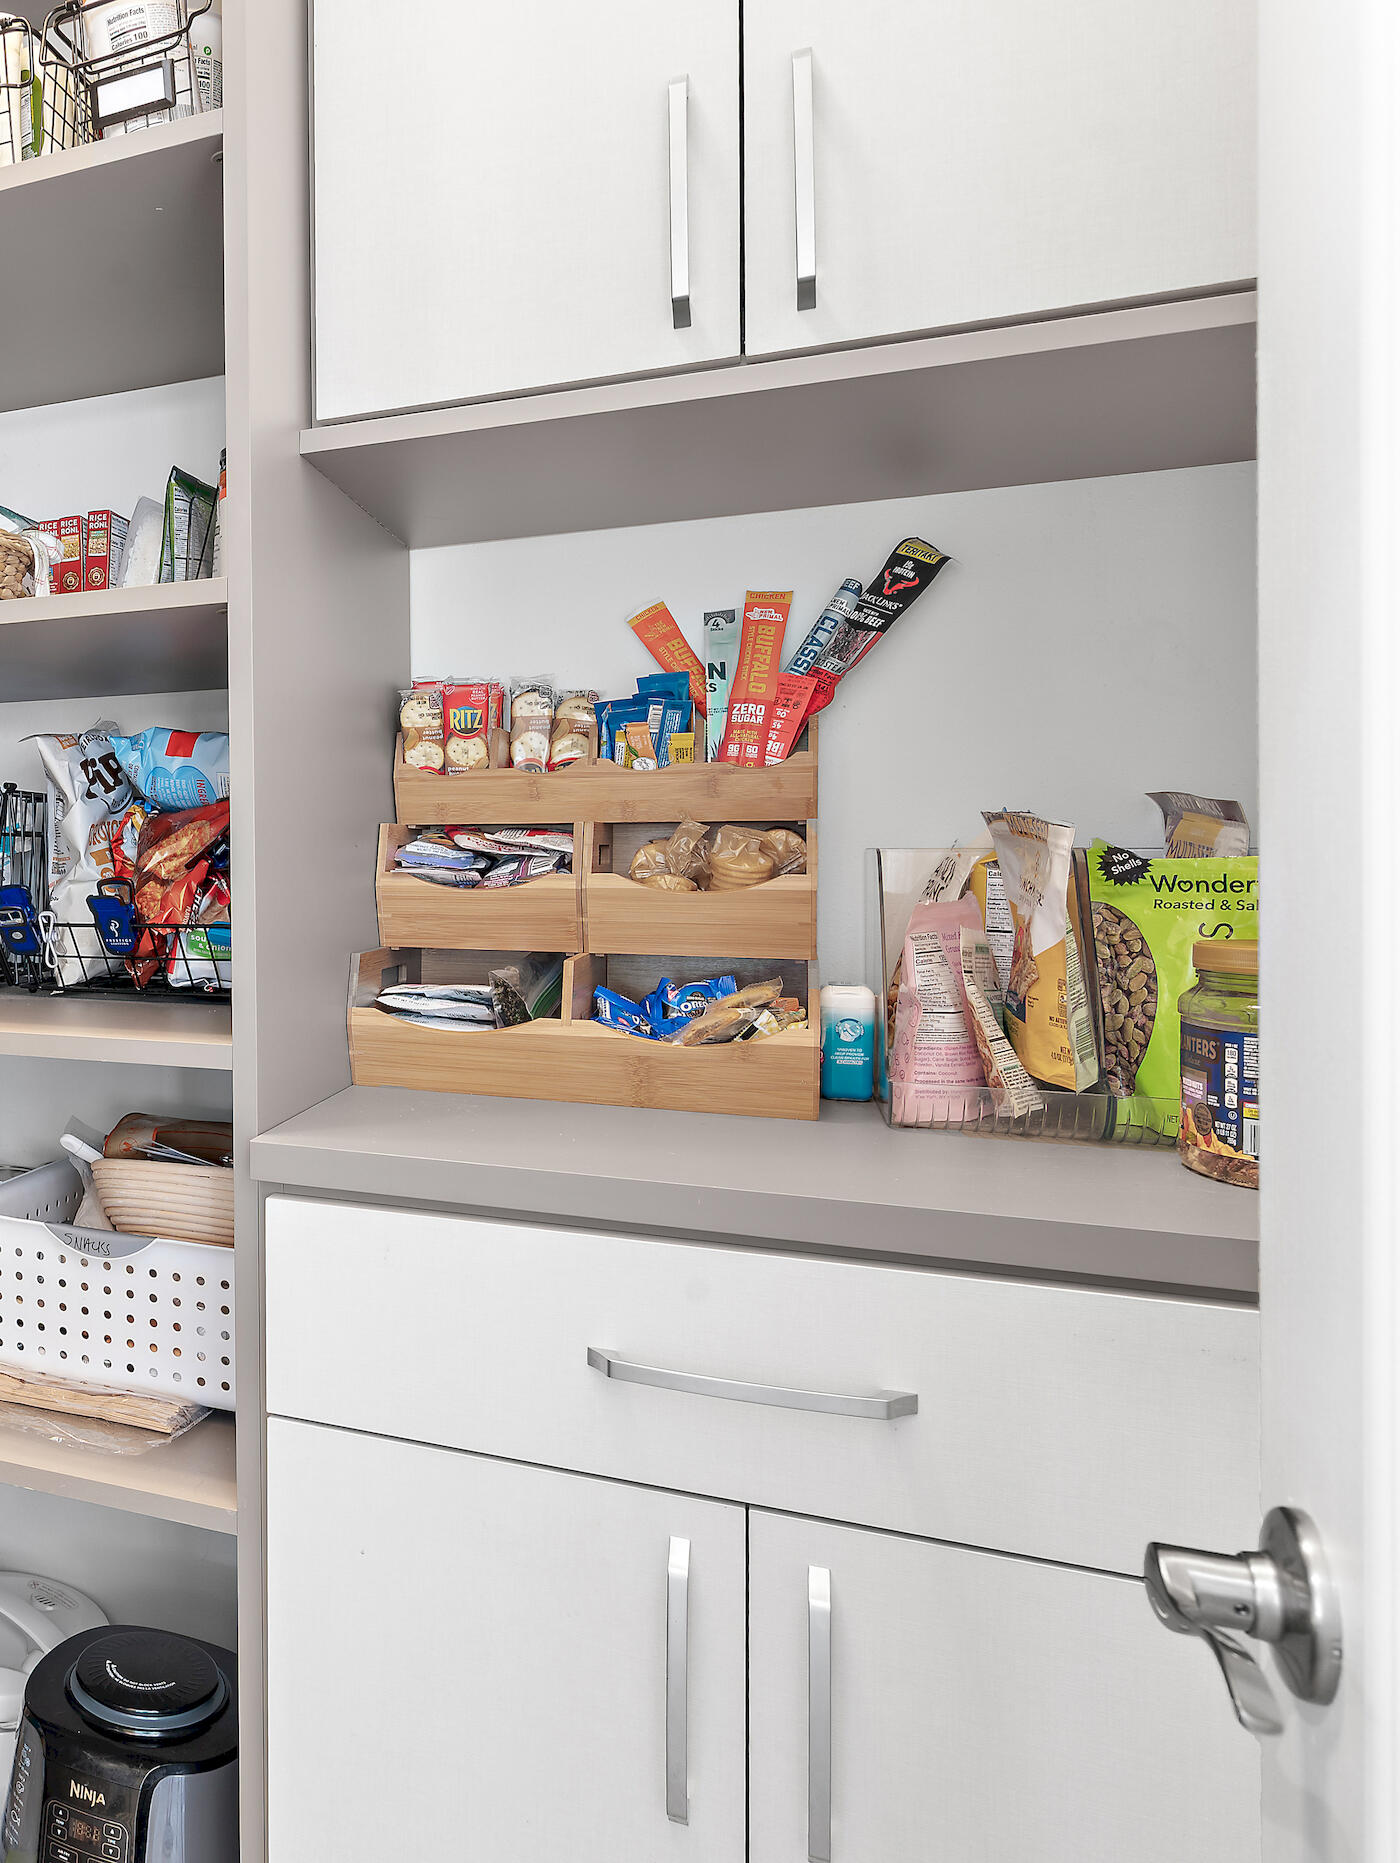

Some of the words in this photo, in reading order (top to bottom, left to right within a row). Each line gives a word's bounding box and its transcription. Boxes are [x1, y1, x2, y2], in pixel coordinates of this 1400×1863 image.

[107, 10, 129, 26] Nutrition
[129, 6, 145, 17] Facts
[133, 30, 149, 41] 100
[60, 518, 78, 527] RICE
[88, 513, 108, 521] RICE
[39, 521, 58, 530] RICE
[901, 544, 939, 562] TERIYAKI
[750, 592, 786, 600] CHICKEN
[711, 618, 721, 629] 4
[864, 614, 886, 628] BEEF
[788, 614, 839, 676] CLASSI
[747, 624, 776, 694] BUFFALO
[707, 661, 727, 681] N
[732, 703, 766, 716] ZERO
[449, 707, 484, 730] RITZ
[731, 714, 764, 725] SUGAR
[528, 724, 551, 732] peanut
[422, 733, 444, 741] peanut
[1112, 852, 1130, 863] No
[1111, 858, 1143, 876] Shells
[1149, 873, 1259, 894] Wonder
[1153, 898, 1215, 911] Roasted
[1220, 899, 1232, 911] &
[1236, 899, 1259, 911] Sal
[191, 934, 207, 942] sou
[680, 1000, 709, 1012] OREO
[64, 1232, 111, 1256] SNACKS
[69, 1779, 106, 1808] NINJA
